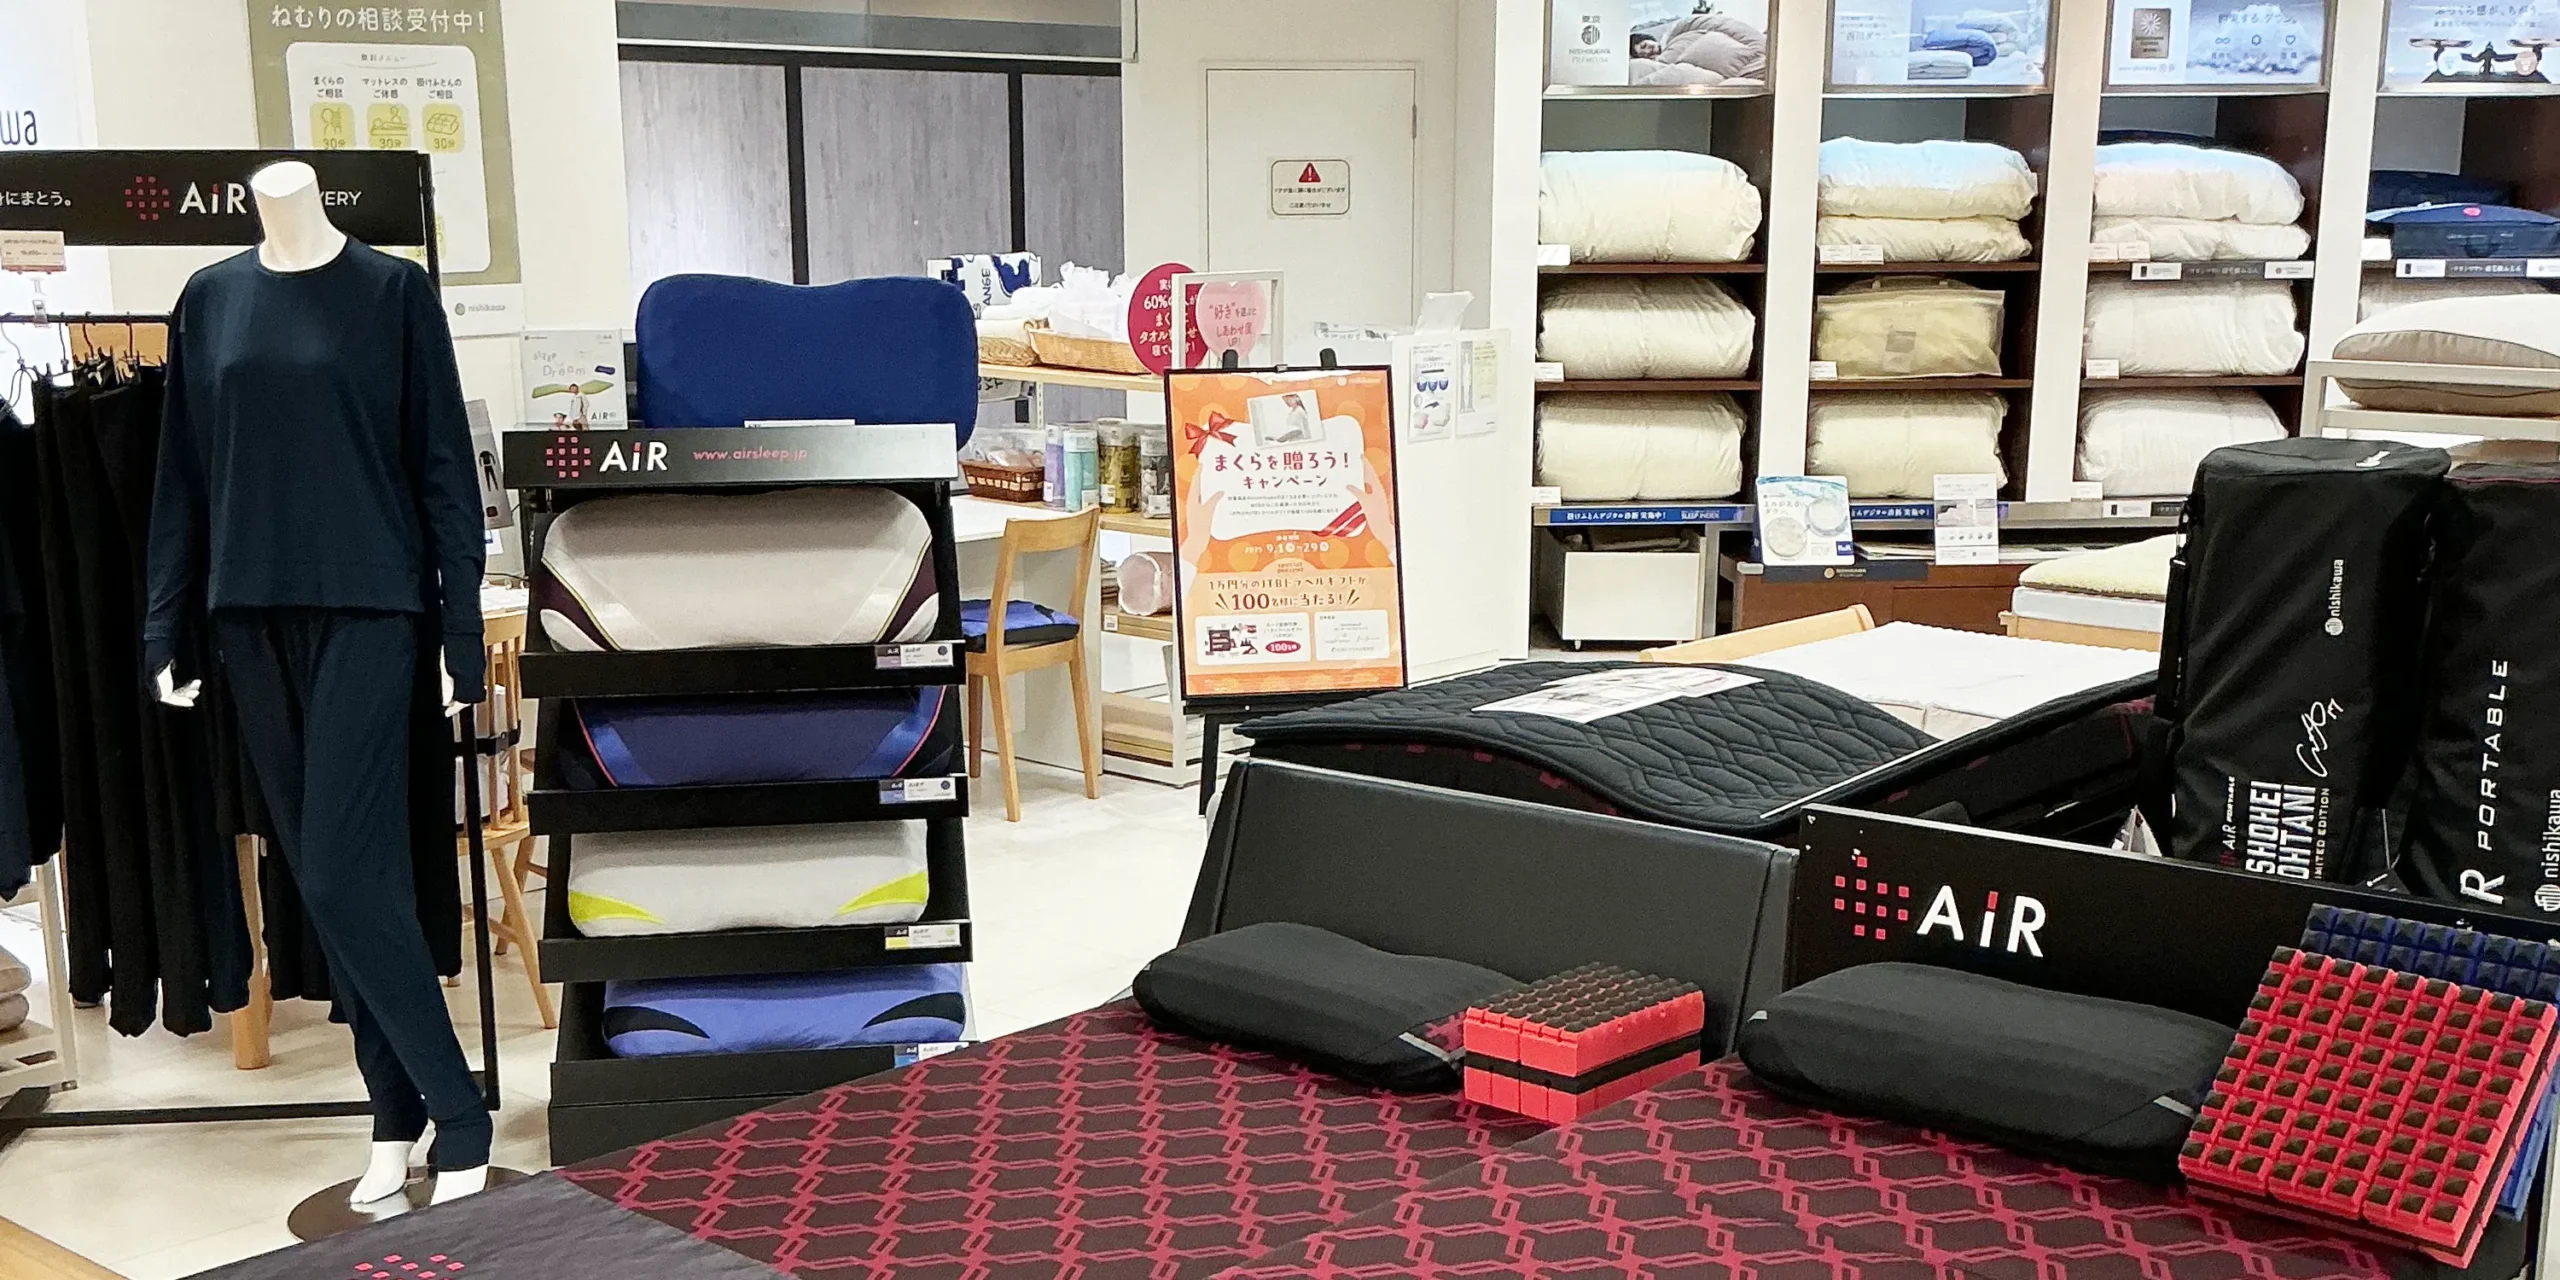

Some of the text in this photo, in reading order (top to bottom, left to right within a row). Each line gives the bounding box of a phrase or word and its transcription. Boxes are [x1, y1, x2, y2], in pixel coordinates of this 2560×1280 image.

[693, 446, 808, 462] www.airsleep.jp
[1243, 475, 1328, 490] キャンペーン
[2329, 559, 2344, 617] nishikawa
[2477, 660, 2508, 850] PORTABLE
[2245, 781, 2282, 874] SHOHEI
[2277, 785, 2317, 880] OHTANI
[2314, 788, 2330, 879] IMITED EDITION
